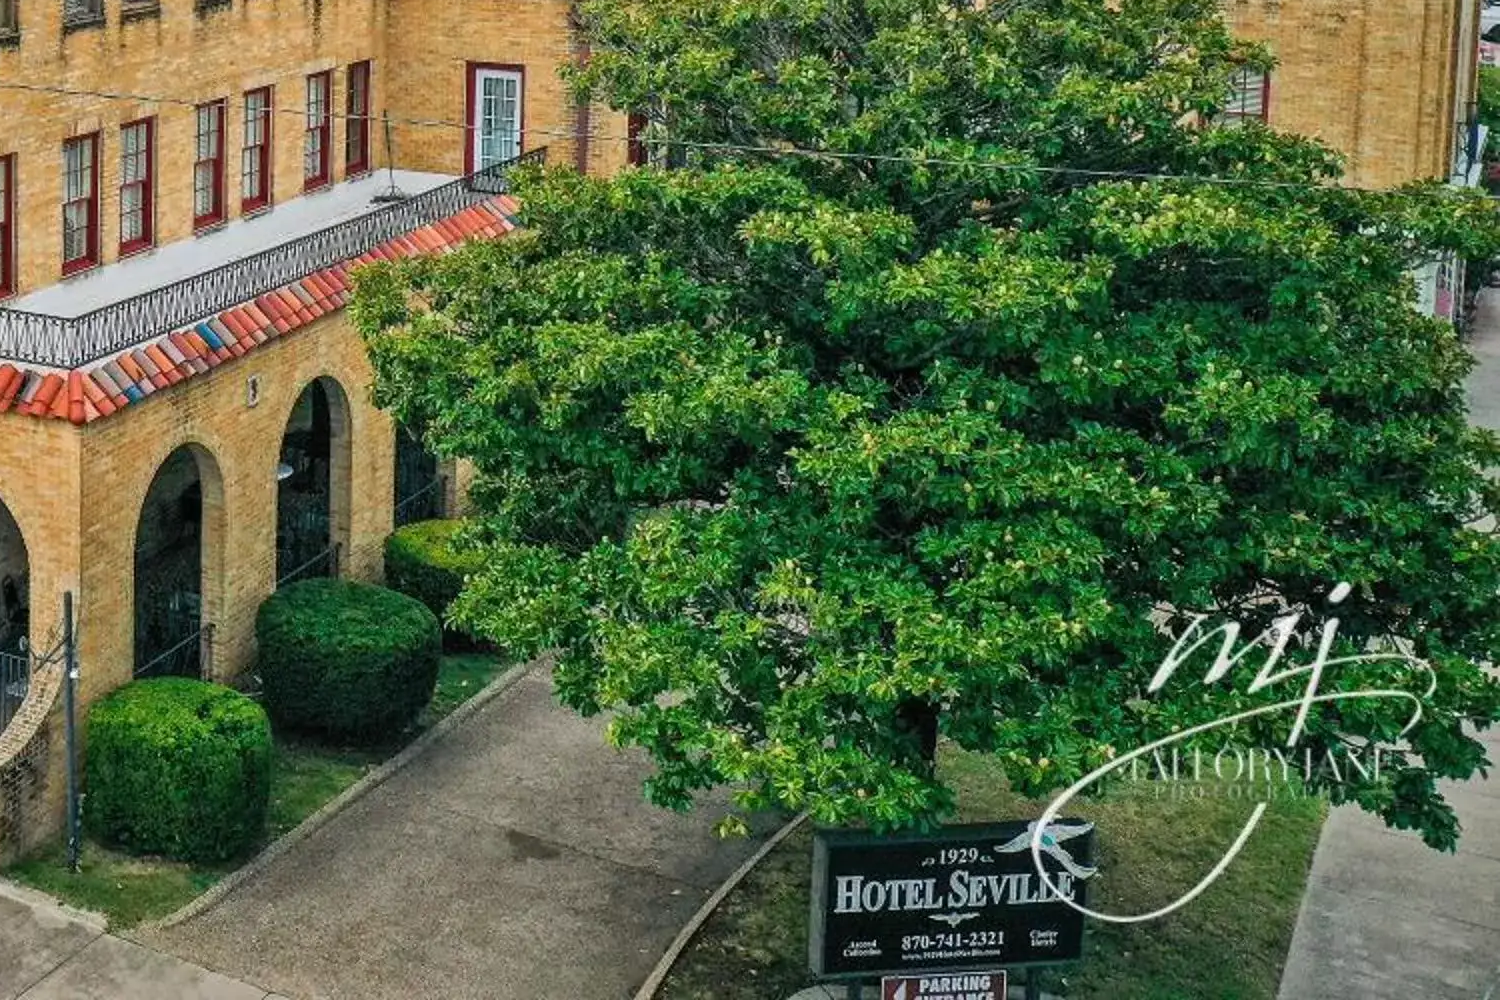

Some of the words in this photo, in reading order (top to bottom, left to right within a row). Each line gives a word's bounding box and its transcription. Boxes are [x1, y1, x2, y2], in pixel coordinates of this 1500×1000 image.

[940, 848, 978, 865] 1929
[901, 931, 1004, 951] 870-741-2321
[919, 975, 991, 993] PARKING
